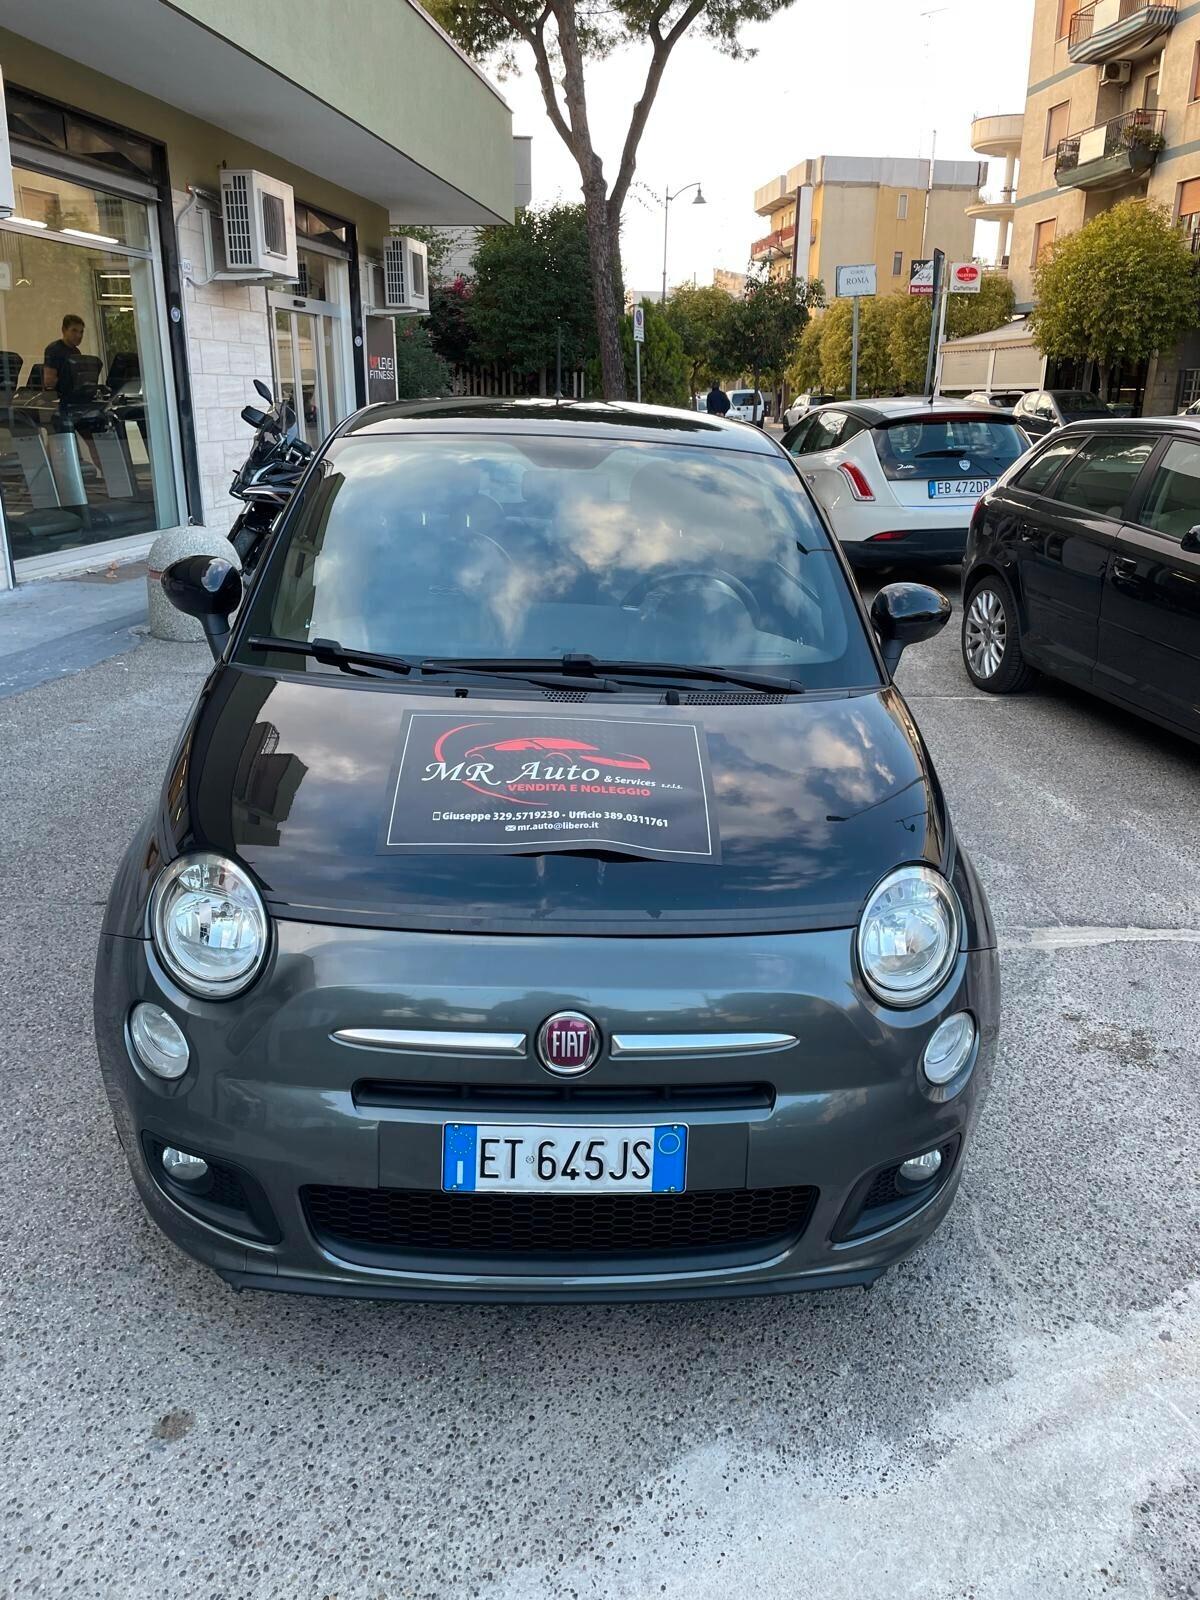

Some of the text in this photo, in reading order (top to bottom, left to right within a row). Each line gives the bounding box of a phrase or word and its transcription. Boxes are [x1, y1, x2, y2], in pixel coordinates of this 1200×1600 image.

[846, 276, 870, 285] ROMA
[370, 370, 394, 380] FITNESS
[937, 482, 951, 494] EB
[956, 481, 989, 493] 472DR
[421, 761, 502, 786] MR
[506, 761, 600, 785] Auto
[604, 774, 613, 783] &
[614, 775, 657, 788] Services
[507, 783, 651, 797] VENDITA E NOLEGGIO
[442, 811, 491, 823] Giuseppe
[493, 809, 560, 822] 329.5719230
[569, 810, 602, 819] Ufficio
[604, 811, 669, 828] 389.0311761
[517, 821, 600, 832] mr.auto@libero.it
[552, 1029, 588, 1058] FIAT
[479, 1138, 524, 1180] ET
[537, 1140, 652, 1181] 645JS
